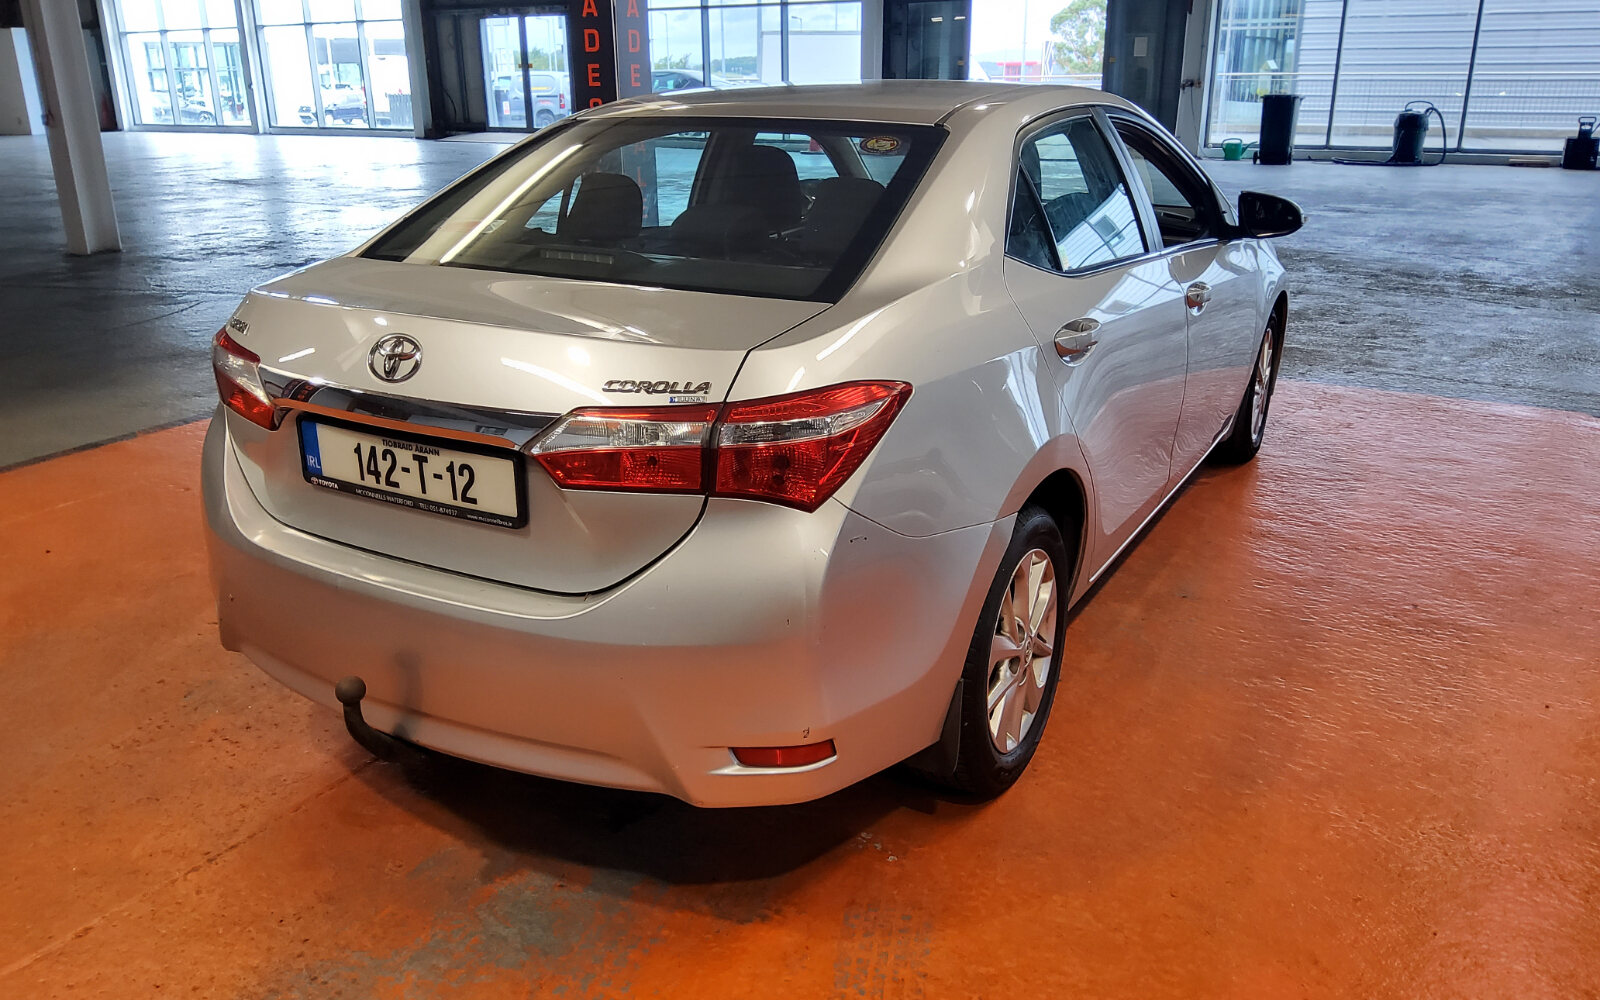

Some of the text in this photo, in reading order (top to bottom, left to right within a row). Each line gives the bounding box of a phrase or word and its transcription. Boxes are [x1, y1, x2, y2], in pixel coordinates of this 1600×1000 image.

[602, 380, 711, 394] COROLLA
[306, 454, 321, 469] IRL
[354, 442, 478, 505] 142-T-12
[318, 479, 339, 490] TOYOTA
